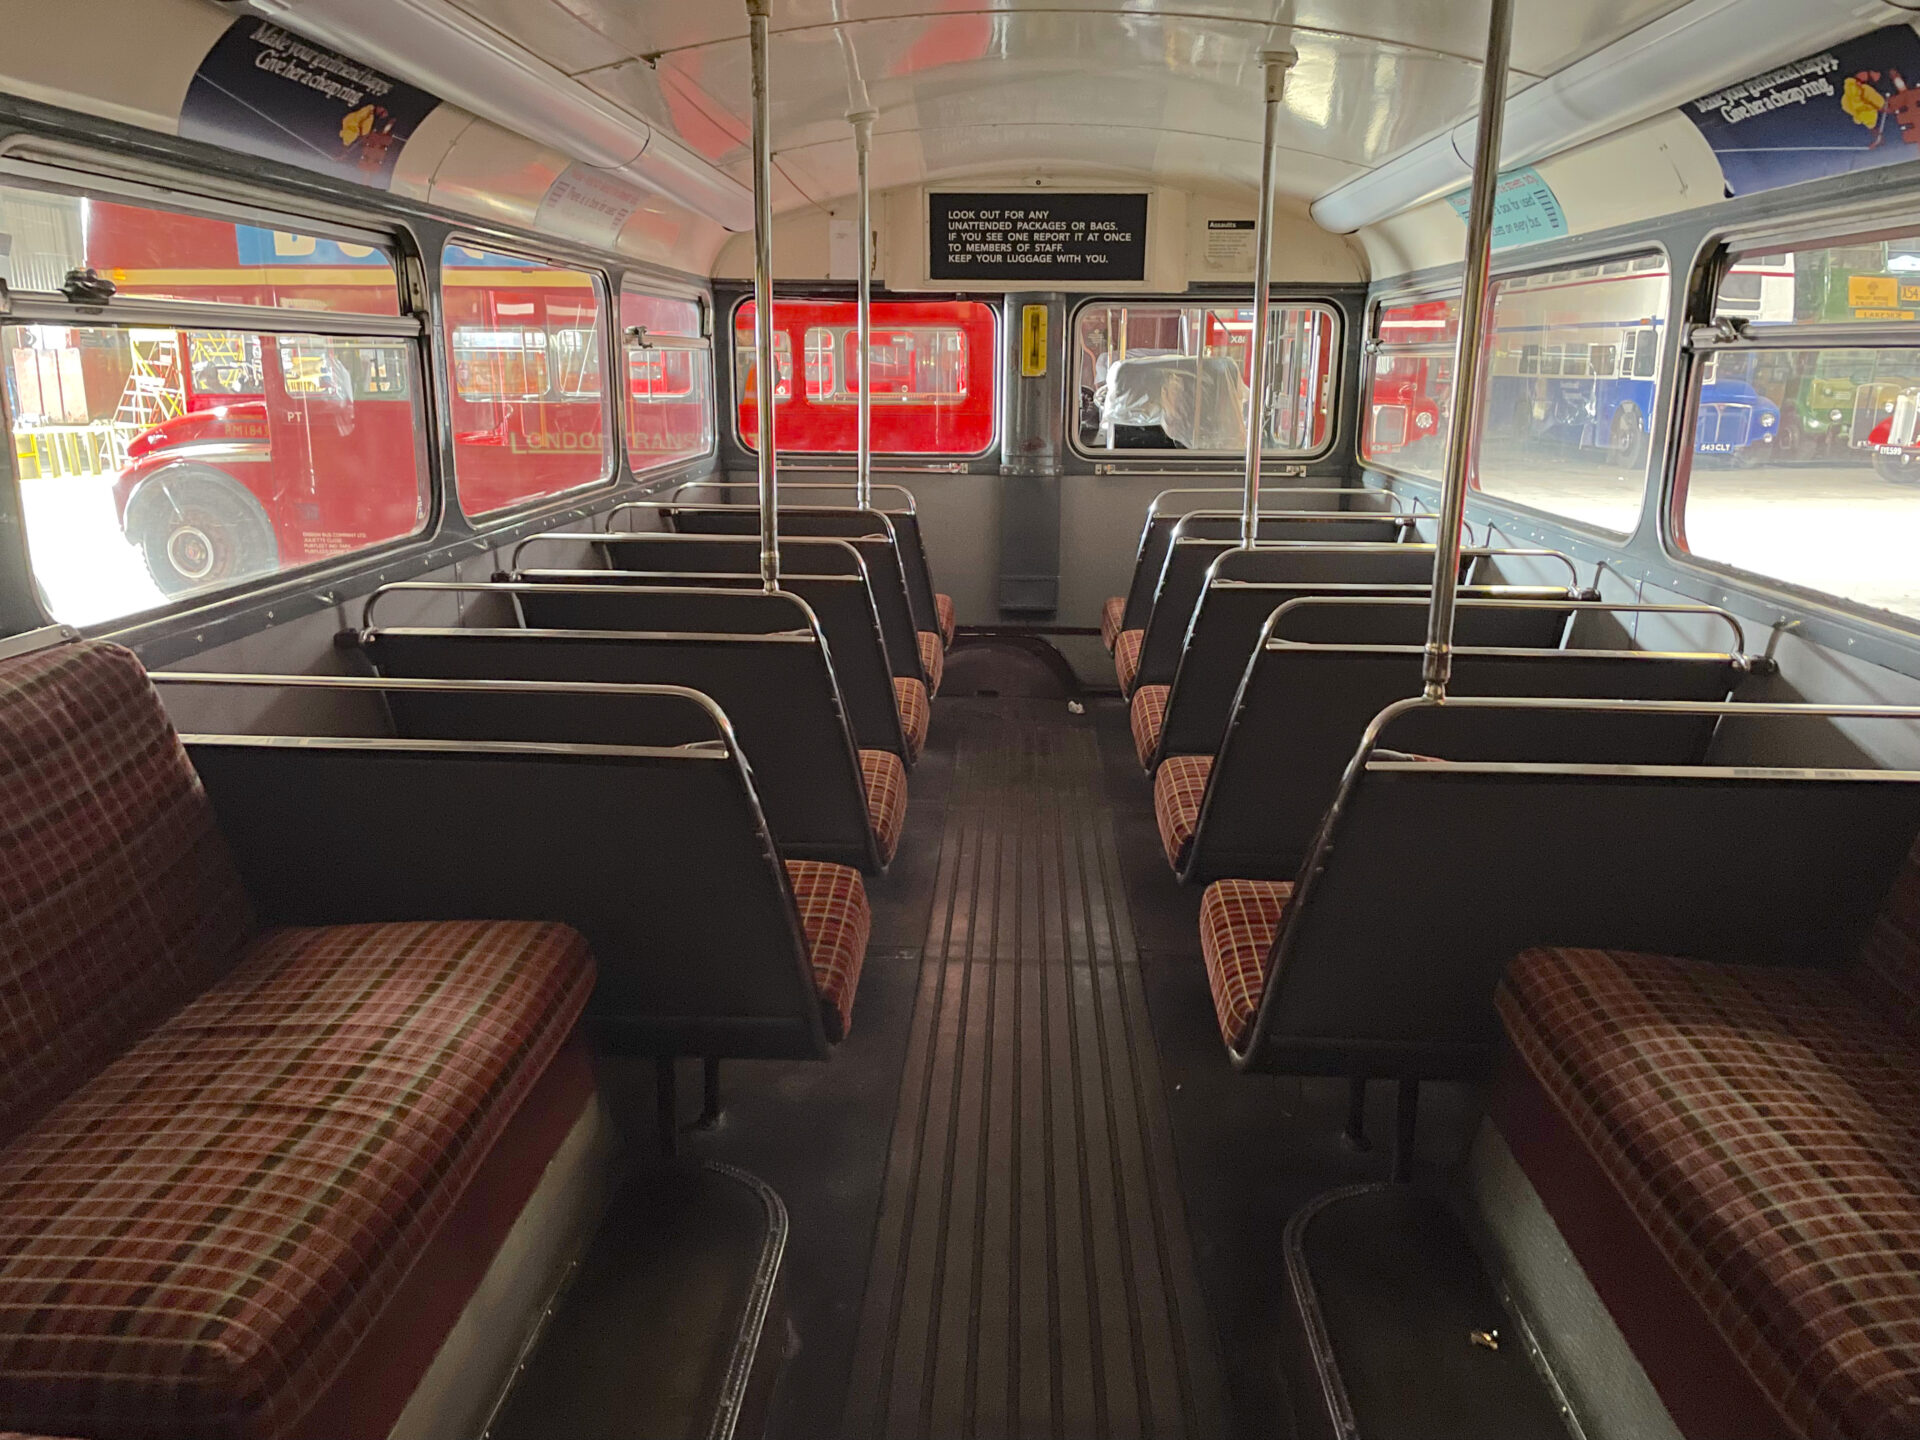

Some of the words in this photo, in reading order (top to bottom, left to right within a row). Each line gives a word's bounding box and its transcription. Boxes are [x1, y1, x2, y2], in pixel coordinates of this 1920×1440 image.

[948, 211, 975, 219] LOOK
[980, 211, 1000, 219] OUT
[1004, 211, 1024, 219] FOR
[1028, 211, 1049, 219] ANY
[948, 222, 1012, 230] UNATTENDED
[1017, 222, 1066, 230] PACKAGES
[1071, 222, 1085, 230] OR
[1090, 222, 1118, 230] BAGS.
[948, 233, 957, 241] IF
[961, 233, 981, 241] YOU
[986, 233, 1003, 241] SEE
[1007, 233, 1029, 241] ONE
[1033, 233, 1070, 241] REPORT
[1074, 233, 1083, 241] IT
[1087, 233, 1099, 241] AT
[1103, 233, 1131, 241] ONCE
[948, 244, 961, 252] TO
[966, 244, 1012, 252] MEMBERS
[1016, 244, 1030, 252] OF
[1035, 244, 1064, 252] STAFF.
[948, 255, 972, 263] KEEP
[976, 255, 1002, 263] YOUR
[1007, 255, 1052, 263] LUGGAGE
[1056, 255, 1081, 263] WITH
[1085, 255, 1108, 263] YOU.
[287, 411, 302, 422] PT
